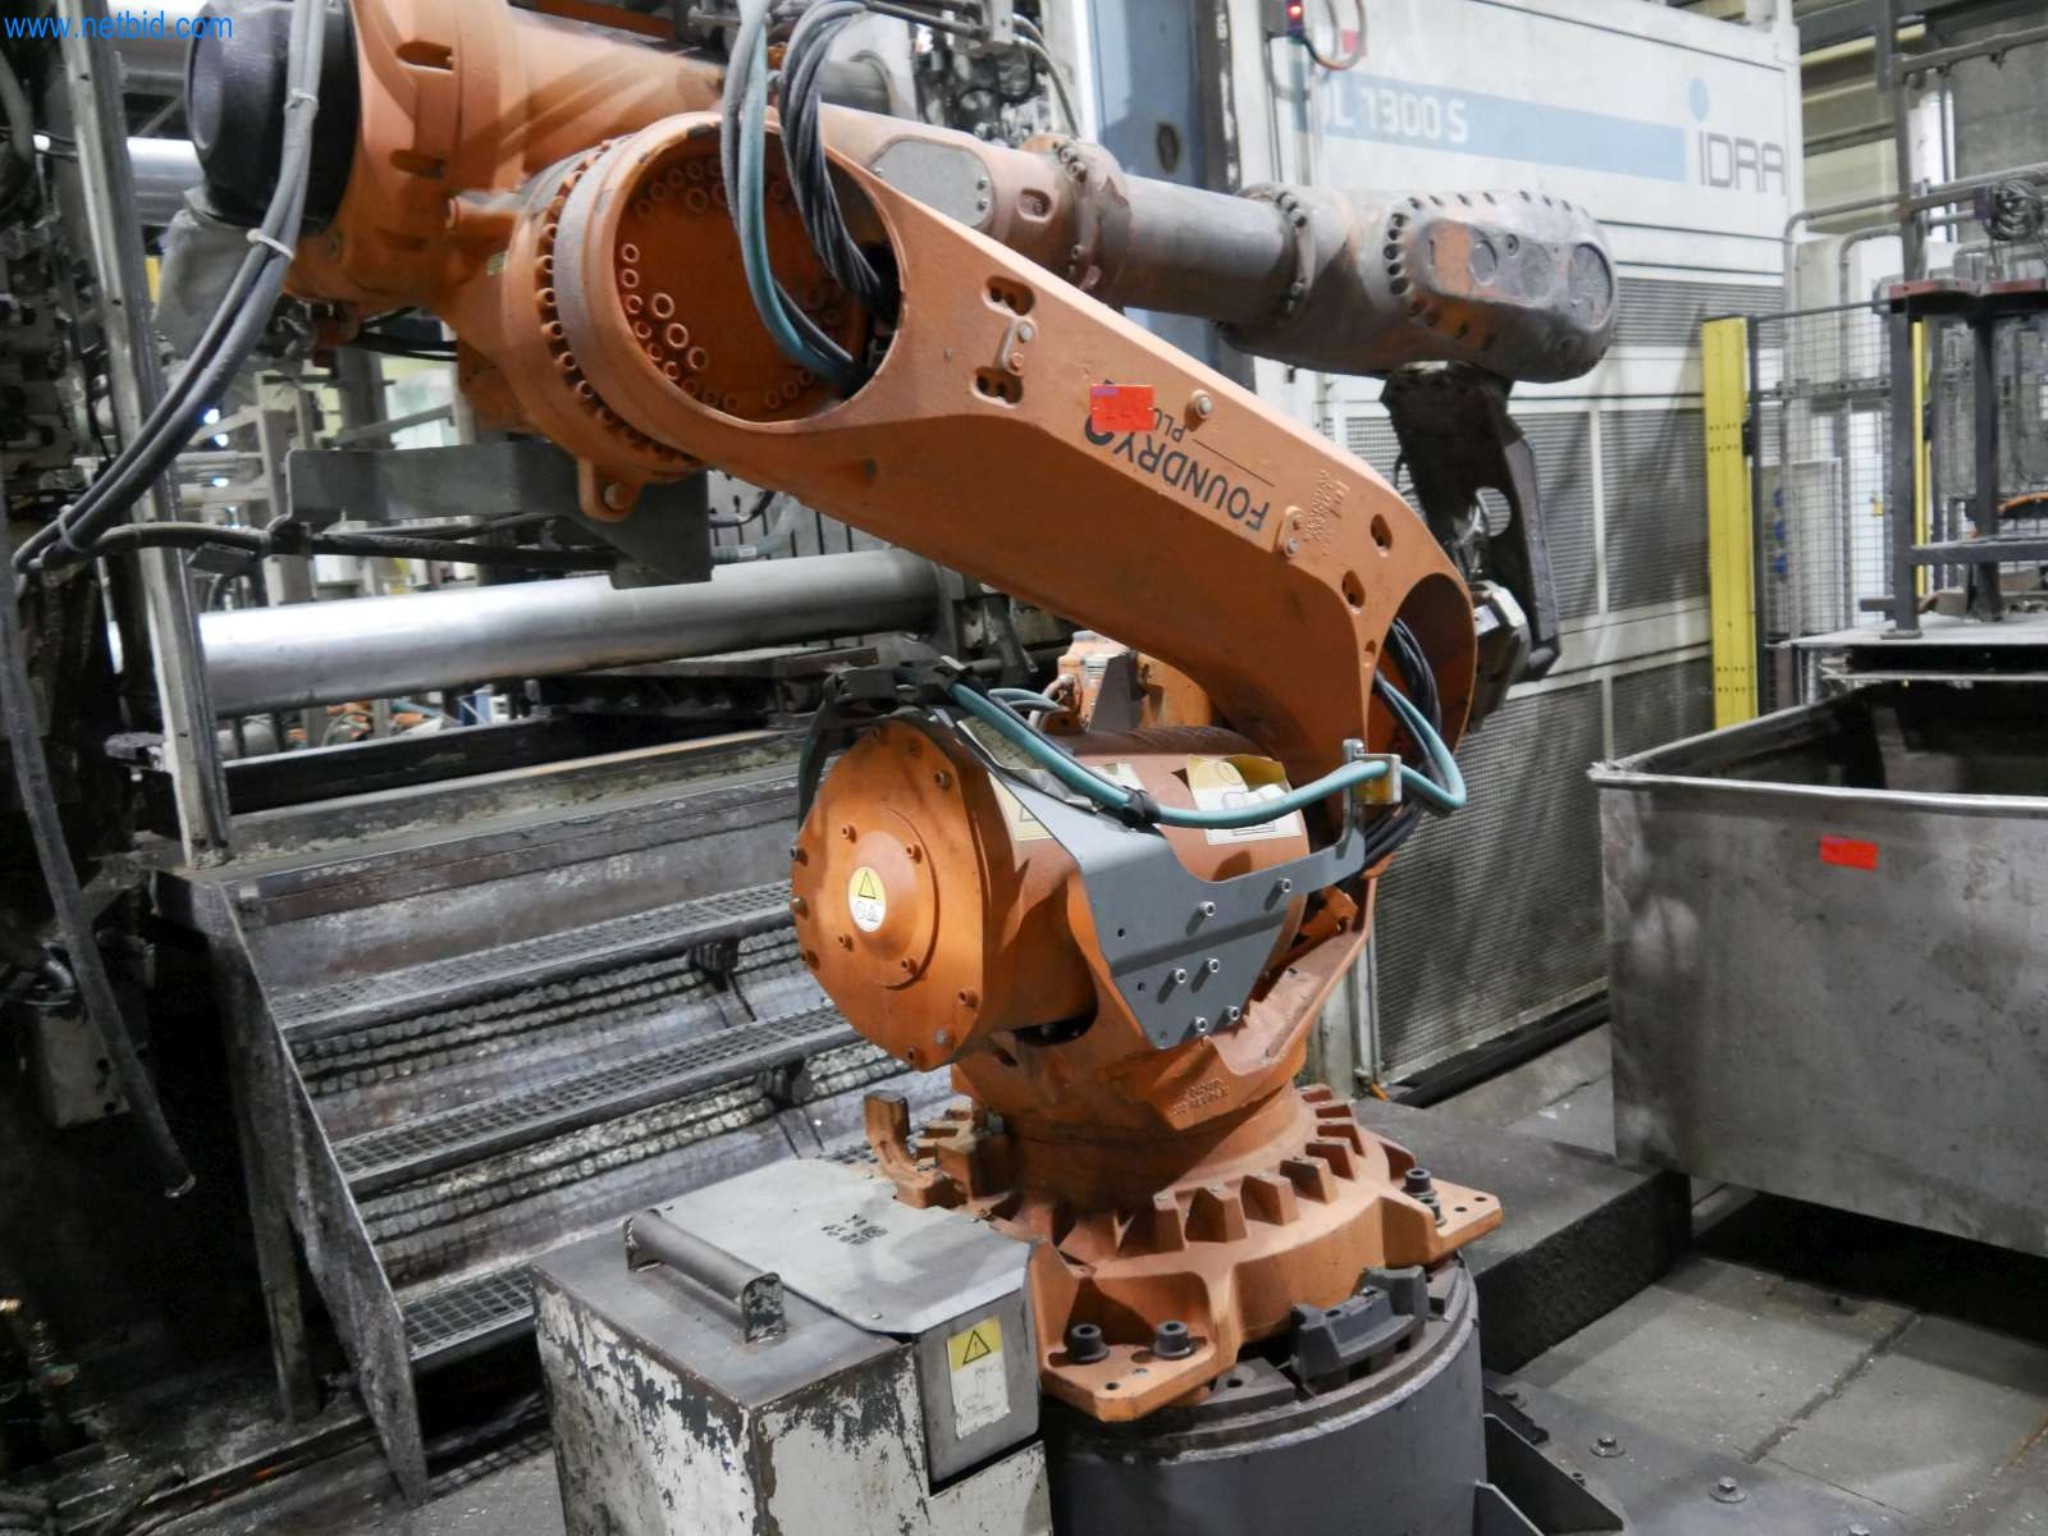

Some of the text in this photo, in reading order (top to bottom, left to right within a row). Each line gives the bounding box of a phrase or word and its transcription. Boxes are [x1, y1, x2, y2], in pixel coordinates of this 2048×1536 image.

[1361, 86, 1441, 141] 1300
[1447, 98, 1469, 144] S
[1112, 431, 1270, 532] FOUNDRY
